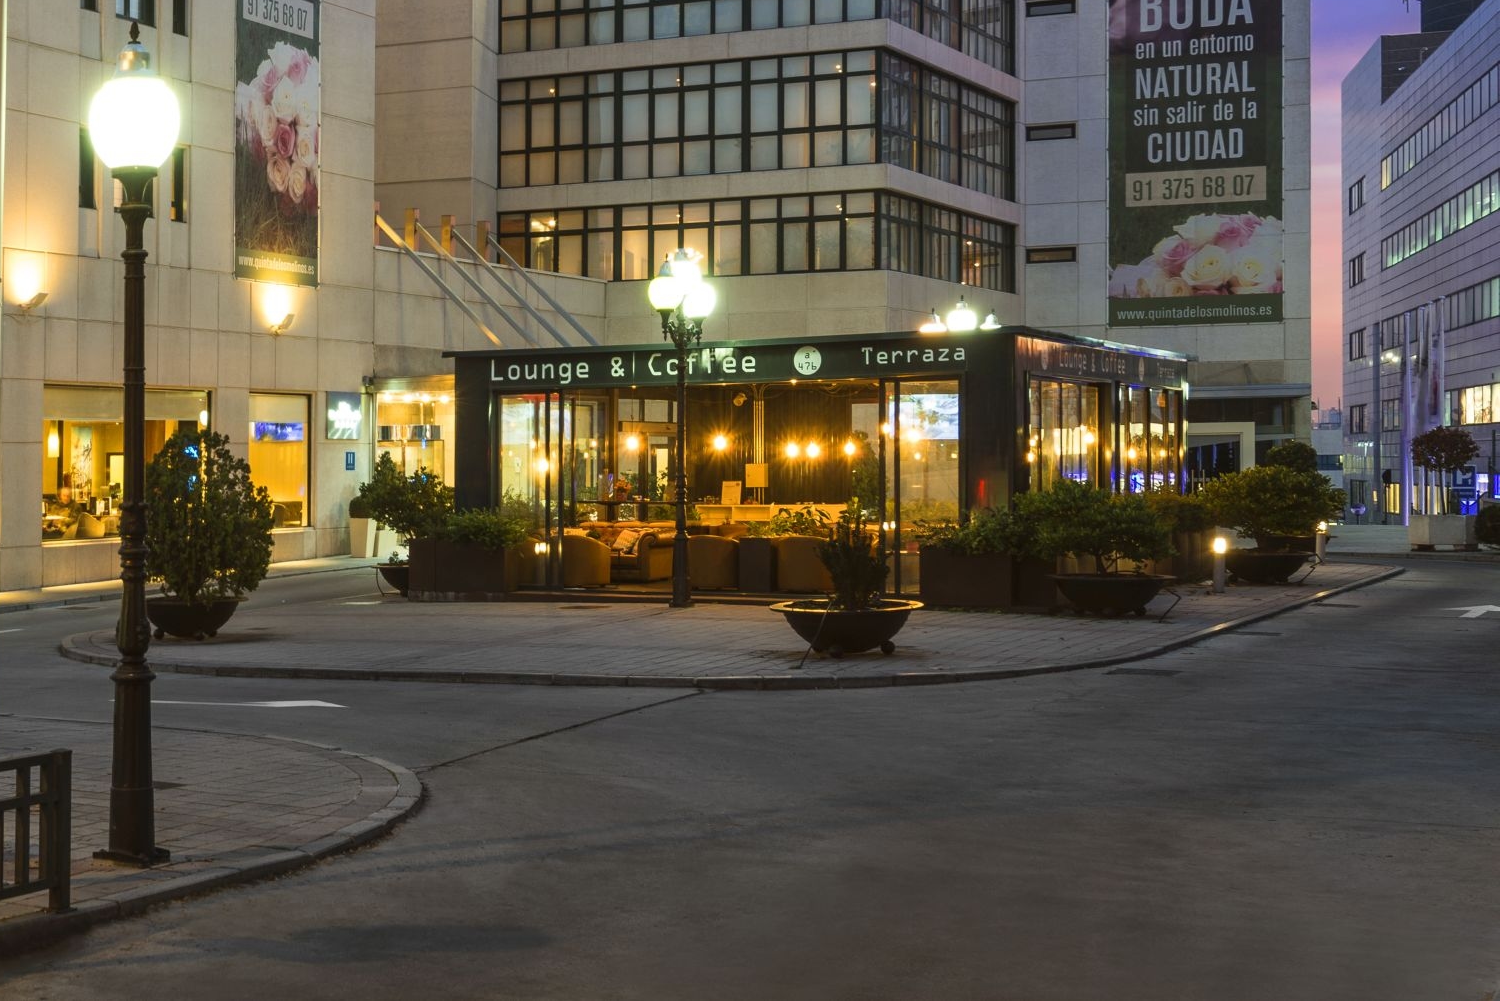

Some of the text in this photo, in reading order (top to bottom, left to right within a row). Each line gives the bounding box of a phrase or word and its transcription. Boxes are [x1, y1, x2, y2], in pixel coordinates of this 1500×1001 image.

[282, 2, 294, 27] 68
[297, 7, 308, 31] 07
[1135, 33, 1254, 60] en un entorno
[1135, 60, 1256, 99] NATURAL
[1133, 97, 1257, 127] sin salir de la
[1147, 127, 1243, 164] CIUDAD
[1132, 174, 1255, 202] 91 375 68 07
[1117, 304, 1273, 322] www.quintadelosmolinos.es
[861, 346, 966, 365] Terraza
[1059, 349, 1087, 375] Lounge
[1101, 350, 1126, 375] Coffee
[491, 359, 589, 384] Lounge
[611, 356, 625, 377] &
